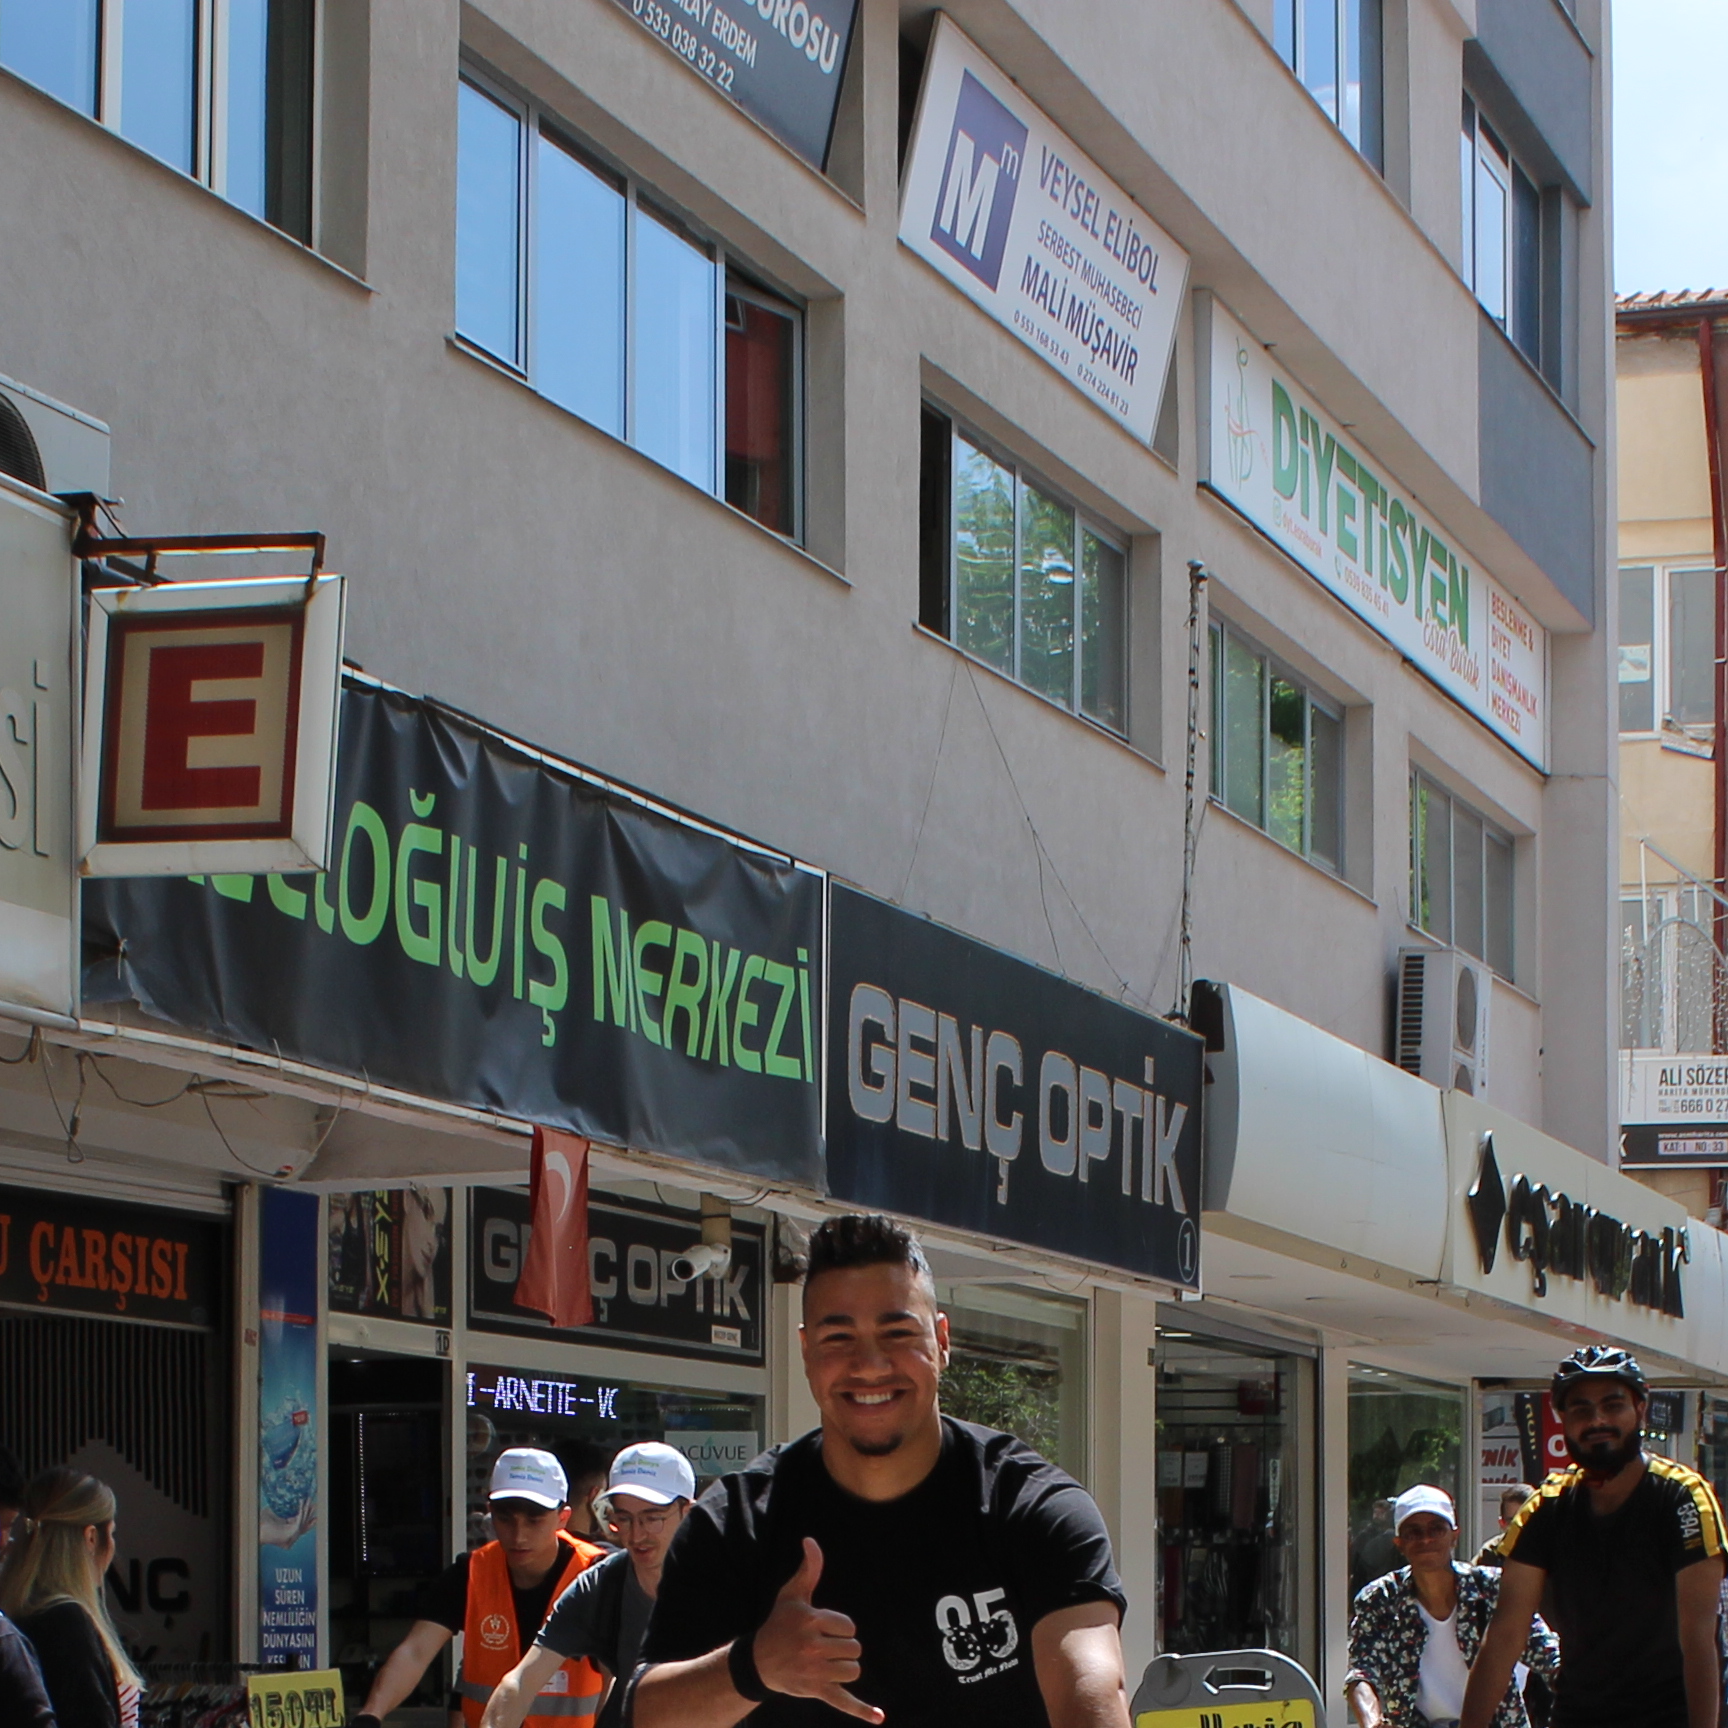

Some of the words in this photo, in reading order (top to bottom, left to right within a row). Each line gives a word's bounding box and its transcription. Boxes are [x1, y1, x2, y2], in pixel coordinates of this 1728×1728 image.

[644, 1, 670, 39] 533
[672, 26, 697, 61] 038
[698, 46, 717, 77] 32
[717, 61, 735, 92] 22
[712, 8, 758, 68] ERDEM
[1039, 145, 1100, 240] VEYSEL
[1103, 210, 1159, 295] ELİBOL
[1013, 310, 1020, 323] 0
[1037, 219, 1082, 274] SERBEST
[1081, 259, 1144, 331] MUHASEBECİ
[1020, 255, 1069, 322] MALİ
[1065, 292, 1139, 386] MÜŞAVİR
[1077, 363, 1083, 377] 0
[1083, 366, 1096, 388] 274
[1096, 377, 1110, 400] 224
[140, 642, 265, 811] E
[590, 895, 814, 1084] MERKEZİ
[848, 982, 1024, 1205] GENÇ
[1038, 1050, 1189, 1214] OPTİK
[1659, 1064, 1682, 1086] ALİ
[1680, 1098, 1703, 1113] 666
[1706, 1098, 1713, 1113] 0
[30, 1222, 189, 1310] ÇARŞISI
[274, 1585, 305, 1605] SÜREN
[275, 1568, 303, 1583] UZUN
